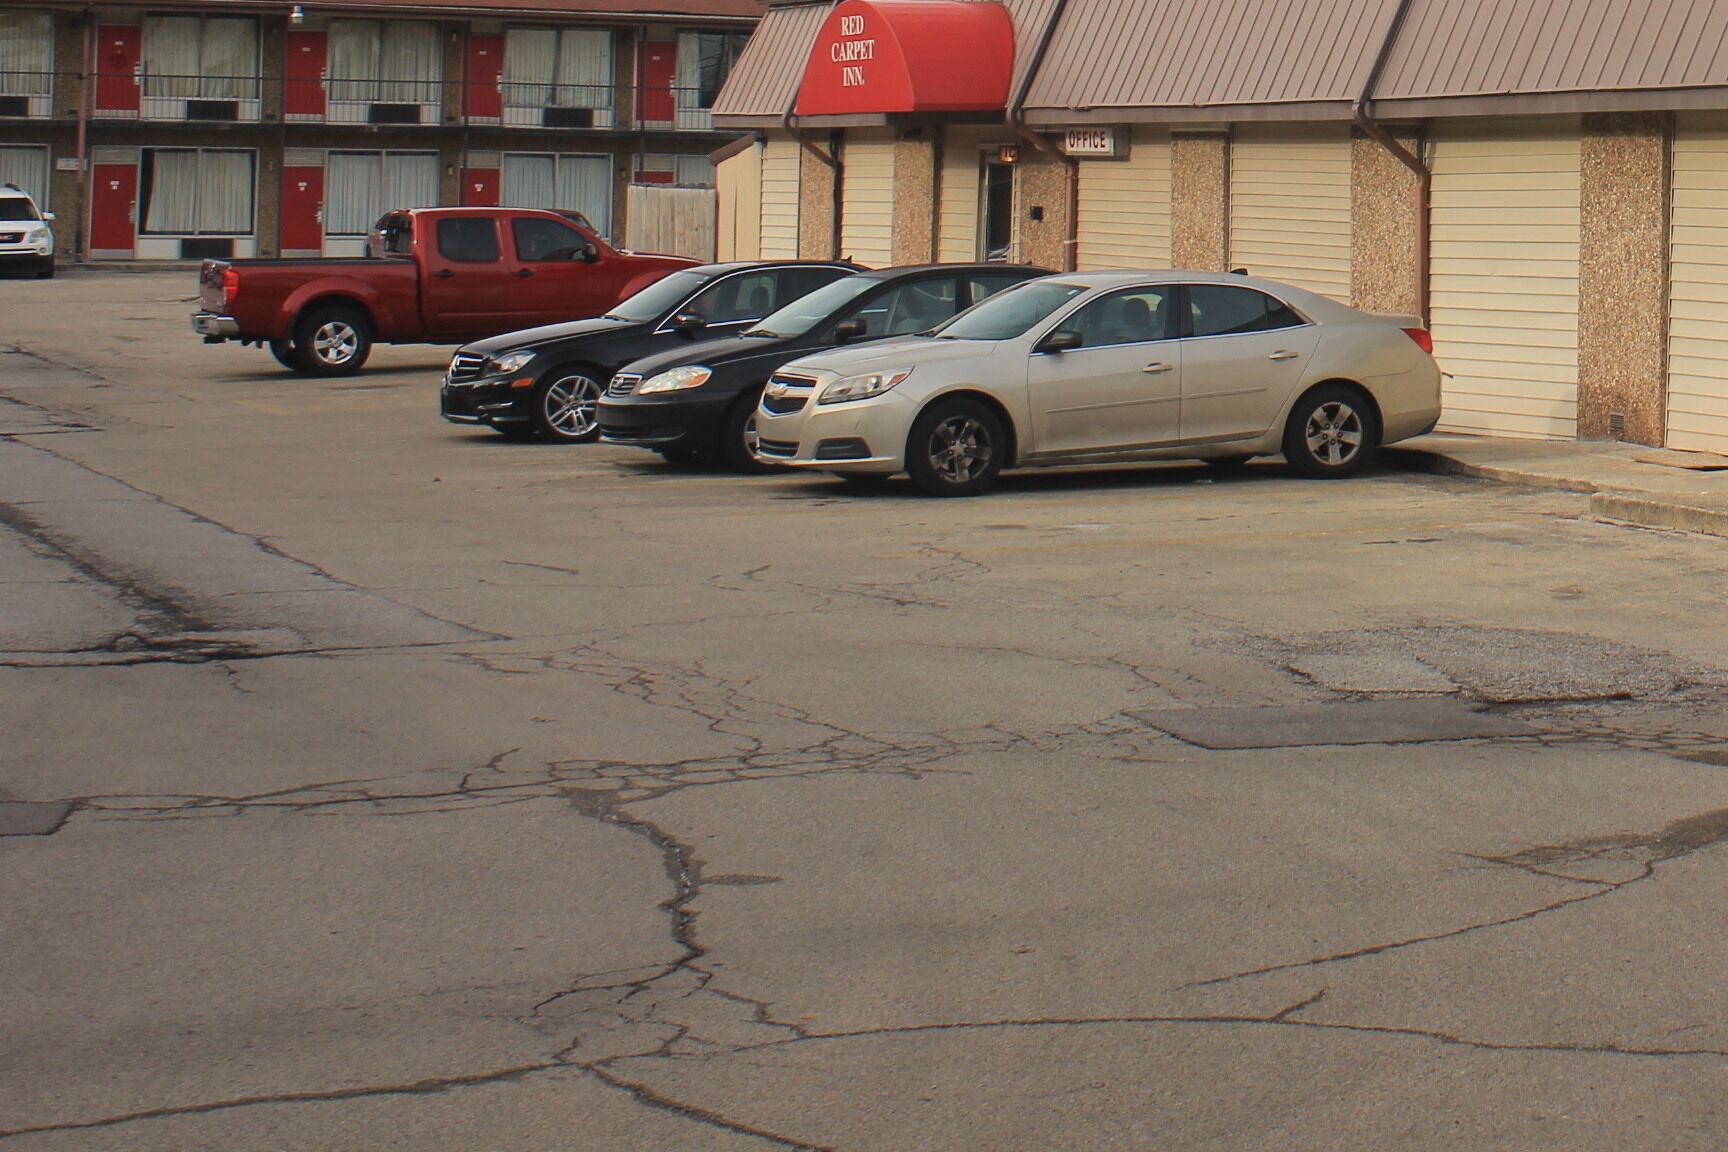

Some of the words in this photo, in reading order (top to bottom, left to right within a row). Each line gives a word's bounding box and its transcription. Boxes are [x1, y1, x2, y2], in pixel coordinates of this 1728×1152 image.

[841, 15, 864, 36] RED
[831, 40, 875, 62] CARPET
[1068, 130, 1106, 148] OFFICE
